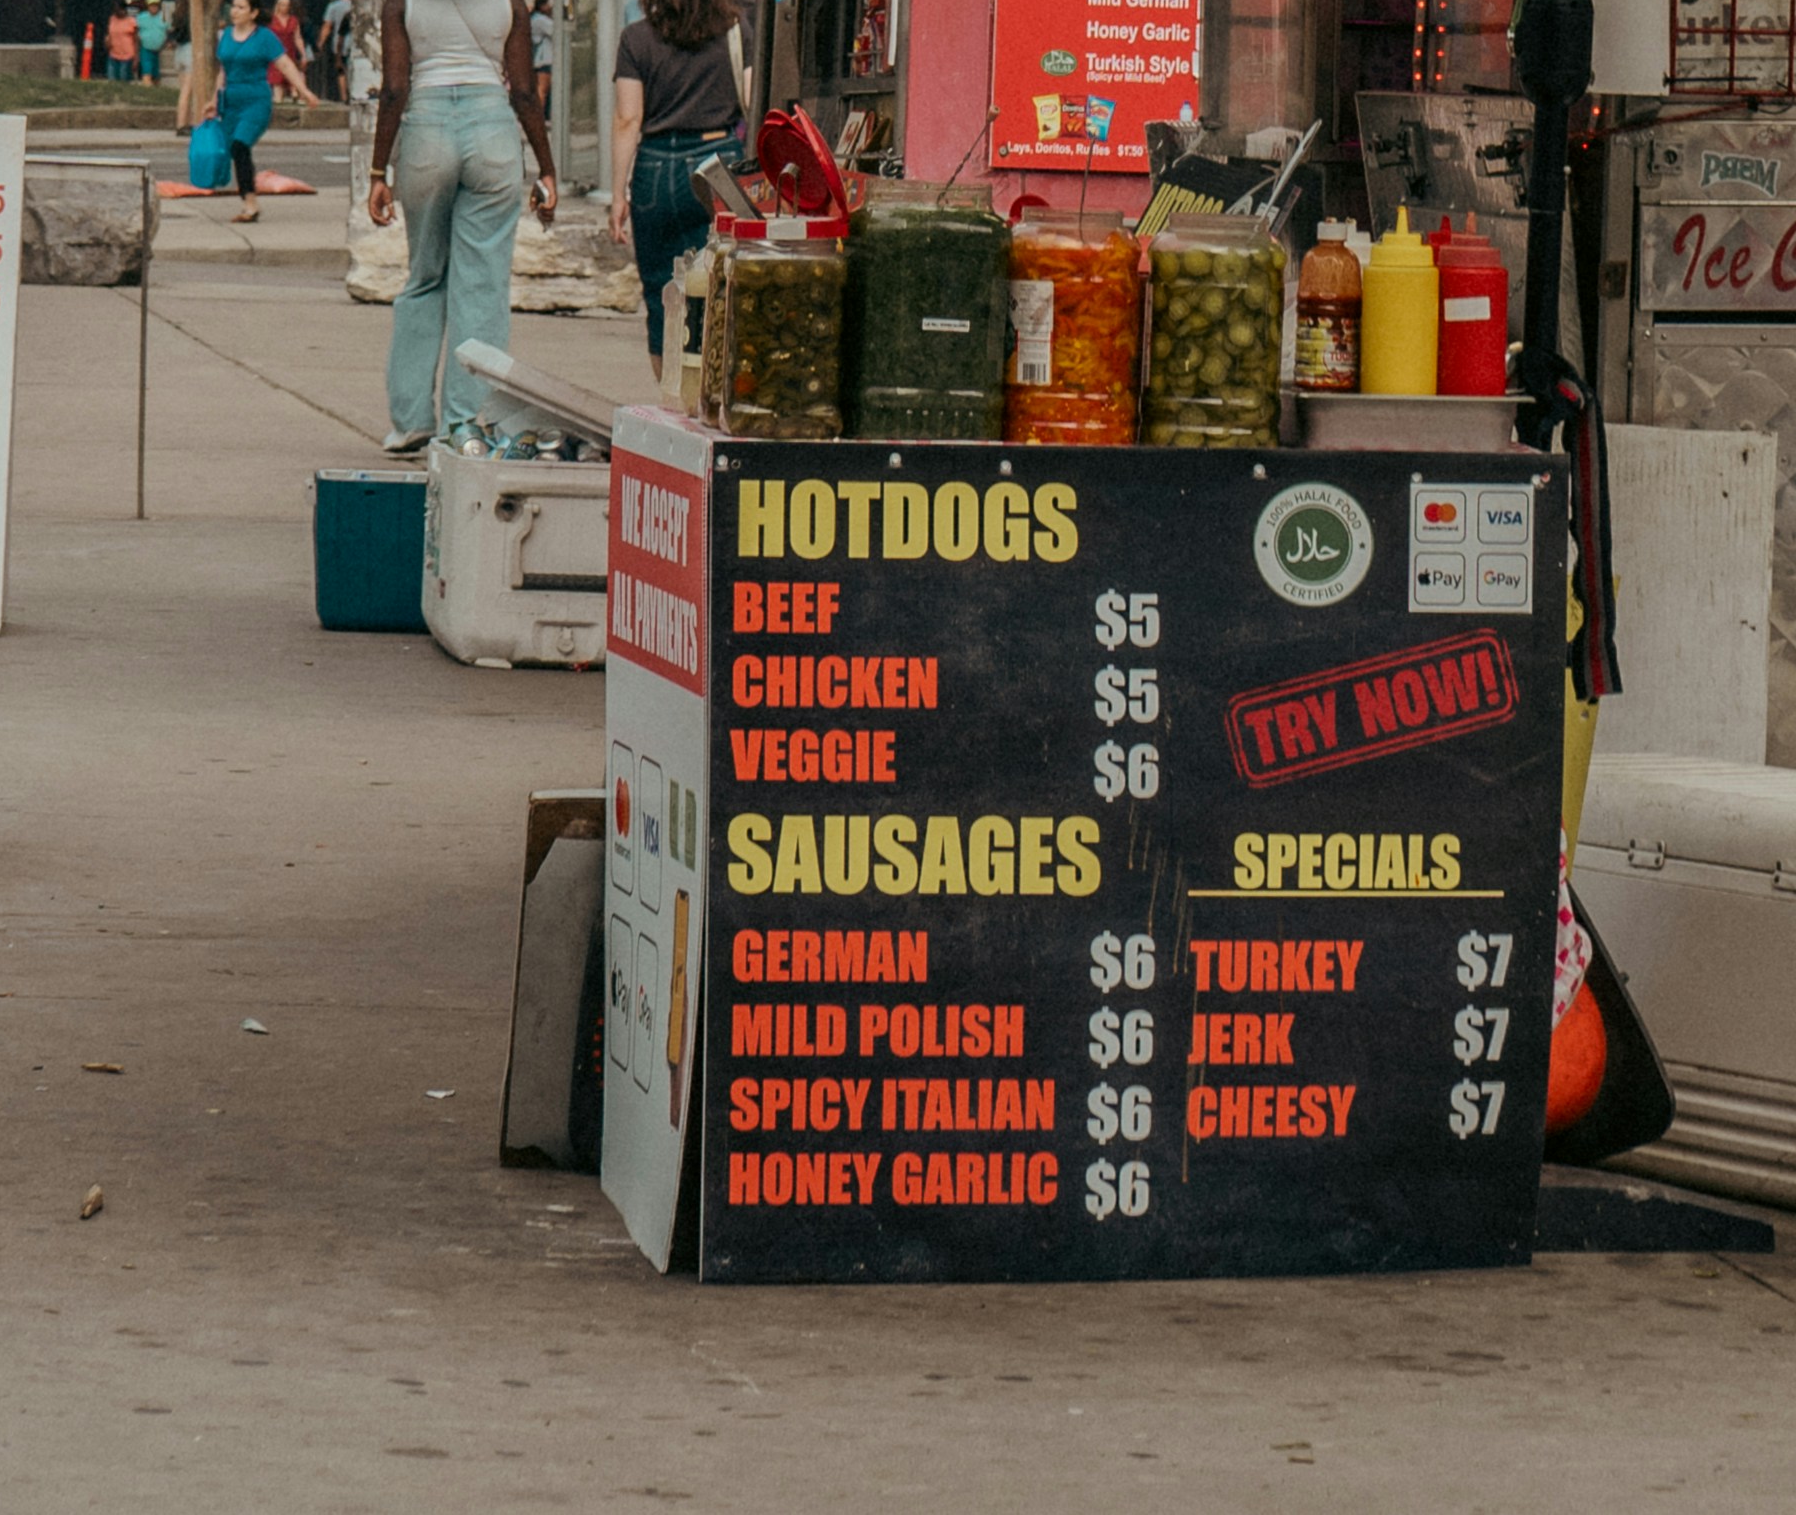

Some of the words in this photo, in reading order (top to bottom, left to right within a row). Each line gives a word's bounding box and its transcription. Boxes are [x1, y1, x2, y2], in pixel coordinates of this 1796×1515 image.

[1087, 21, 1138, 44] Honey
[1142, 22, 1190, 42] Garlic
[1086, 52, 1145, 72] Turkish
[1151, 56, 1190, 78] Style
[1007, 141, 1032, 156] Lays,
[1035, 143, 1072, 156] Doritos,
[1673, 211, 1753, 292] Ice
[621, 474, 641, 548] WE
[641, 482, 690, 568] ACCEPT
[737, 480, 1078, 563] HOTDOGS
[1266, 499, 1293, 528] 100%
[1294, 490, 1332, 504] HALAL
[1334, 498, 1361, 530] FOOD
[1487, 511, 1522, 524] VISA
[1283, 581, 1345, 600] CERTIFIED
[1432, 570, 1462, 588] Pay
[612, 570, 633, 643] ALL
[634, 579, 698, 676] PAYMENTS
[731, 583, 839, 633] BEEF
[1094, 589, 1161, 649] $5
[731, 656, 939, 709] CHICKEN
[1094, 664, 1161, 726] $5
[1244, 690, 1339, 765] TRY
[1355, 649, 1500, 738] NOW!
[729, 729, 896, 783] VEGGIE
[1093, 740, 1160, 802] $6
[642, 812, 659, 861] VISA
[727, 814, 1101, 896] SAUSAGES
[1234, 832, 1462, 890] SPECIALS
[731, 930, 930, 983] GERMAN
[1089, 931, 1156, 992] $6
[1190, 940, 1364, 992] TURKEY
[1456, 931, 1513, 992] $7
[730, 1005, 849, 1058] MILD
[860, 1005, 1025, 1058] POLISH
[1088, 1006, 1155, 1068] $6
[1188, 1014, 1295, 1066] JERK
[1453, 1005, 1510, 1067] $7
[728, 1078, 870, 1132] SPICY
[881, 1078, 1054, 1132] ITALIAN
[1086, 1083, 1153, 1145] $6
[1186, 1086, 1356, 1139] CHEESY
[1449, 1080, 1505, 1142] $7
[728, 1152, 879, 1206] HONEY
[891, 1152, 1059, 1206] GARLIC
[1084, 1158, 1151, 1219] $6
